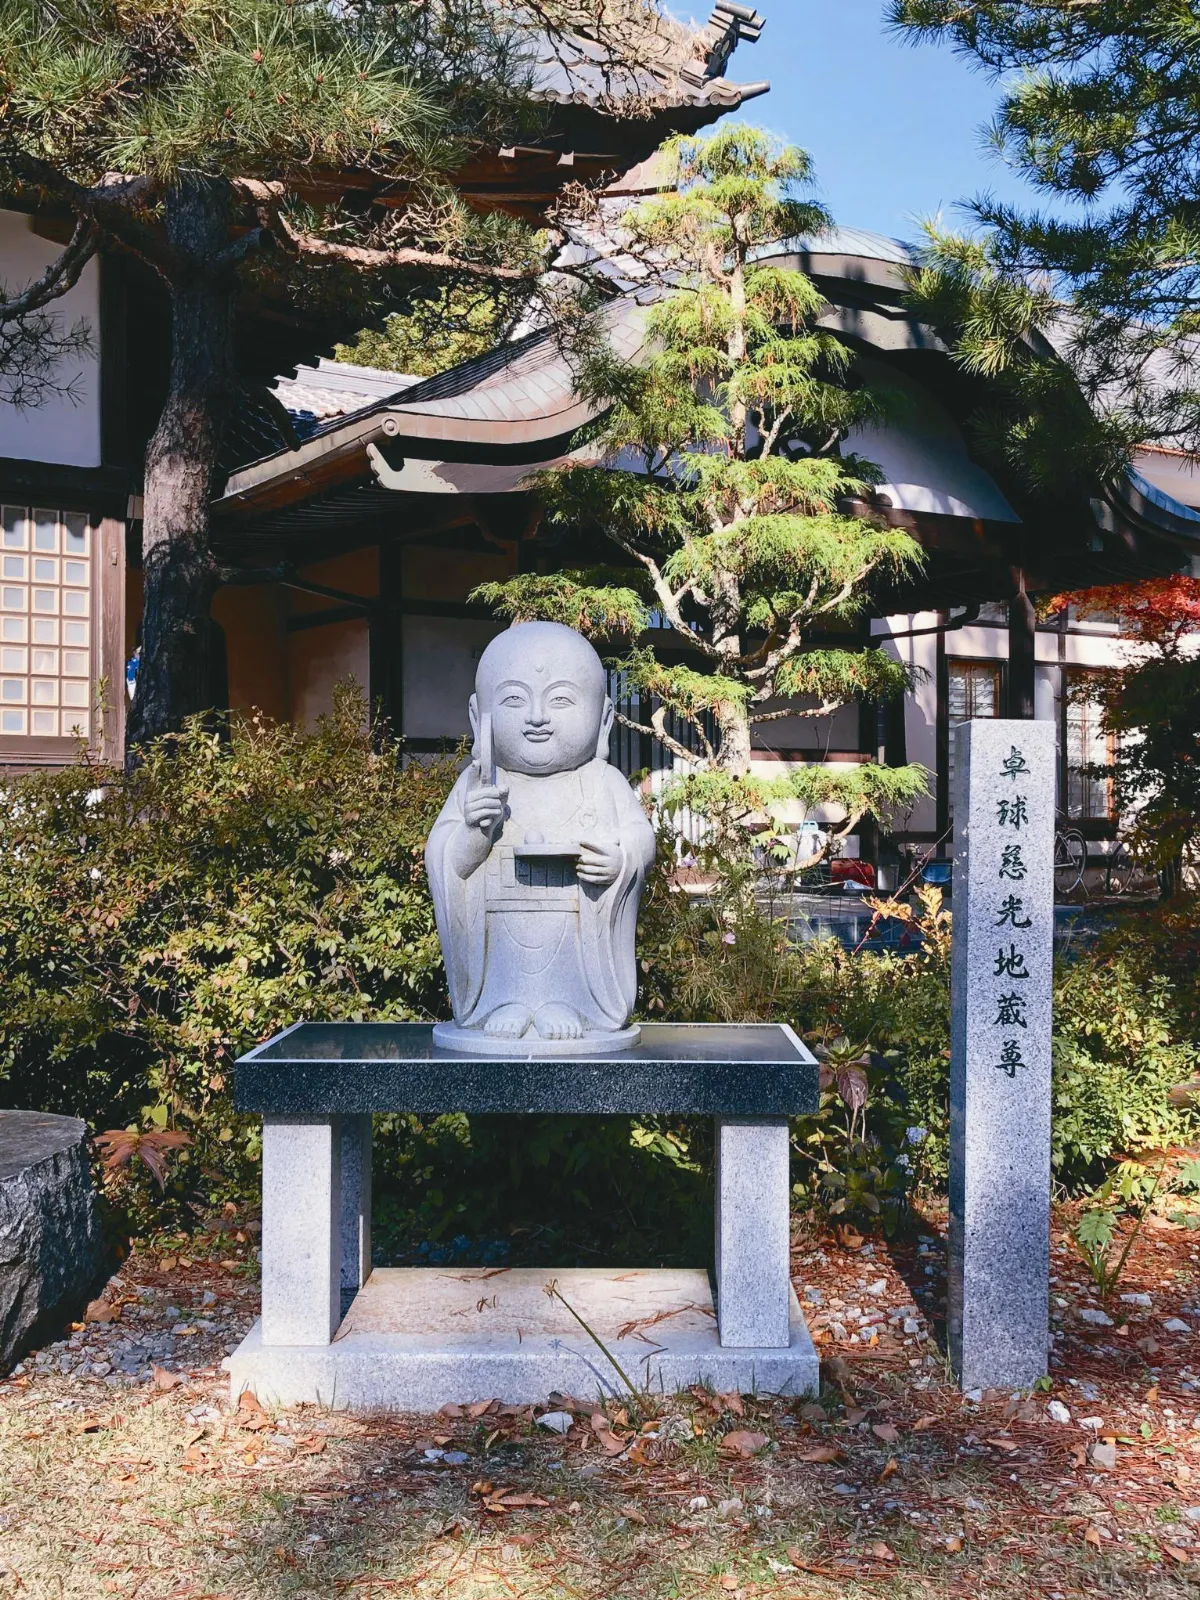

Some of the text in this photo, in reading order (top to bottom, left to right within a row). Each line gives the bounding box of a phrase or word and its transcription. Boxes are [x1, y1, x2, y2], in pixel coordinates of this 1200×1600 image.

[993, 745, 1032, 1078] 卓球慈光地蔵尊
